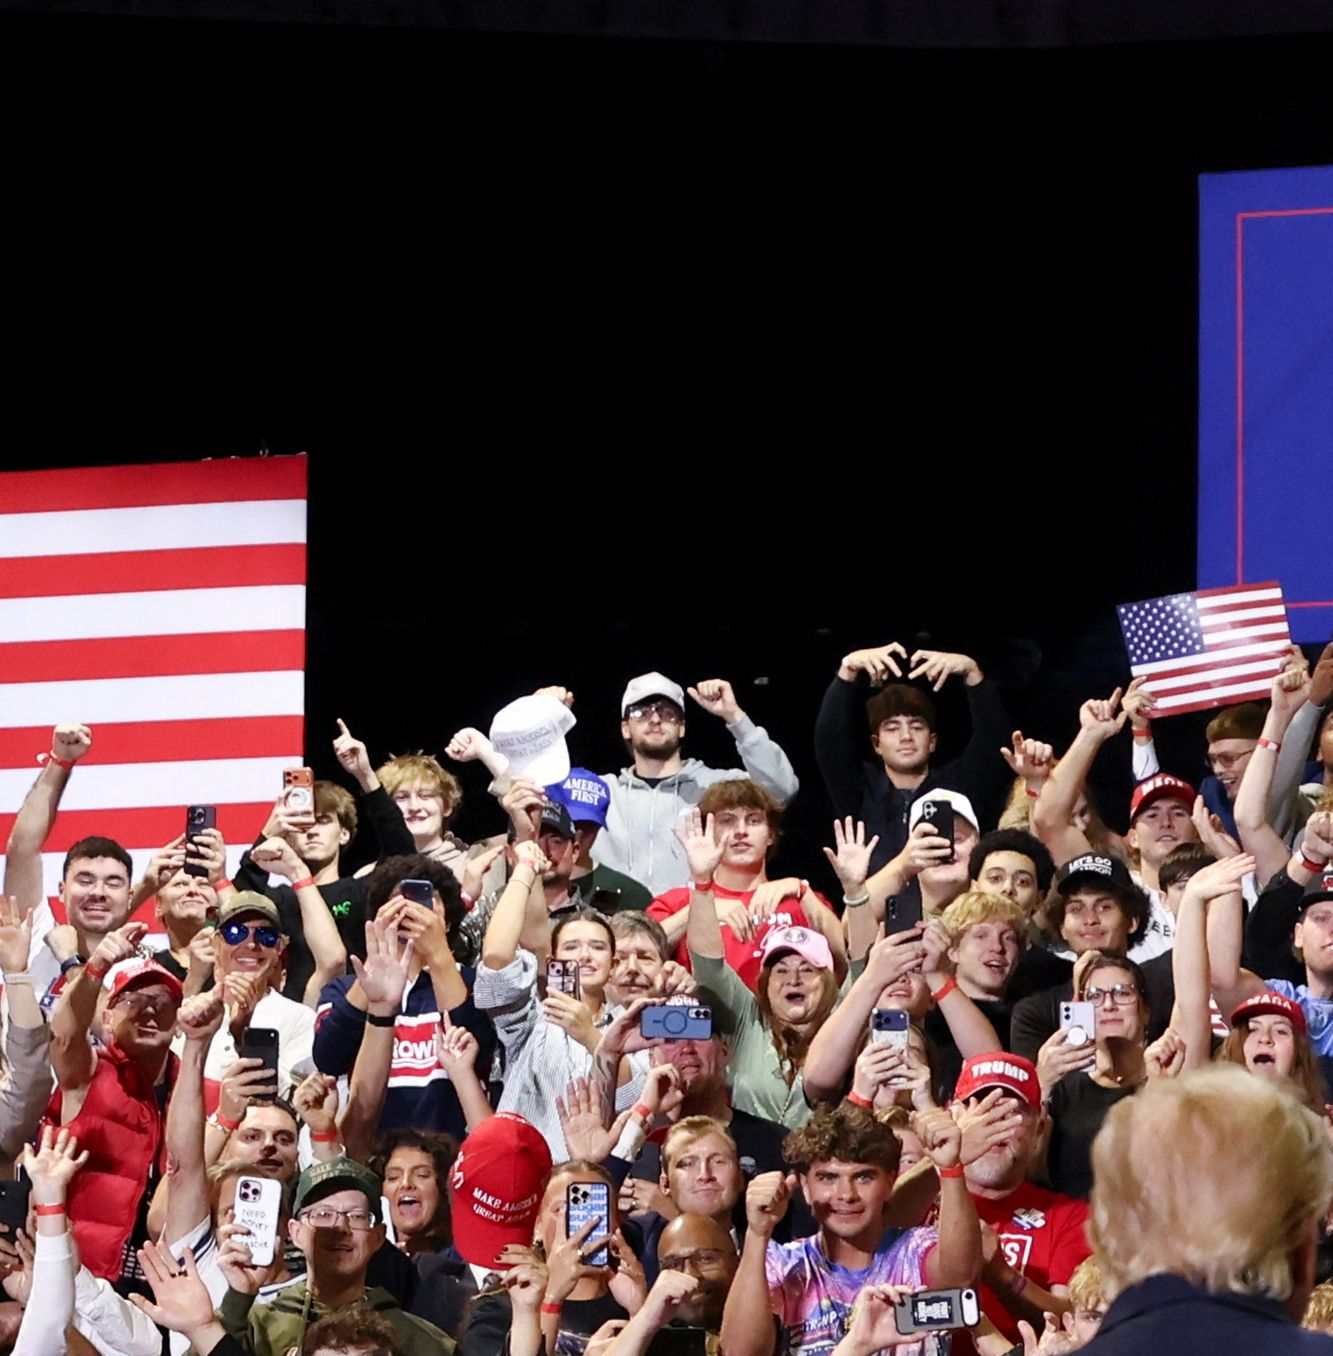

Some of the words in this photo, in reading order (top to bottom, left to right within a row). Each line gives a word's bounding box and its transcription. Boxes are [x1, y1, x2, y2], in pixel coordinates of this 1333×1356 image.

[563, 778, 607, 799] AMERICA
[570, 789, 600, 806] FIRST
[1069, 856, 1093, 870] LET'S
[1094, 856, 1112, 867] GO
[971, 1060, 1030, 1082] TRUMP
[472, 1187, 502, 1210] MAKE
[242, 1208, 266, 1219] NEED
[472, 1202, 505, 1223] GREAT
[570, 1203, 606, 1214] sugar
[570, 1213, 606, 1223] sugr
